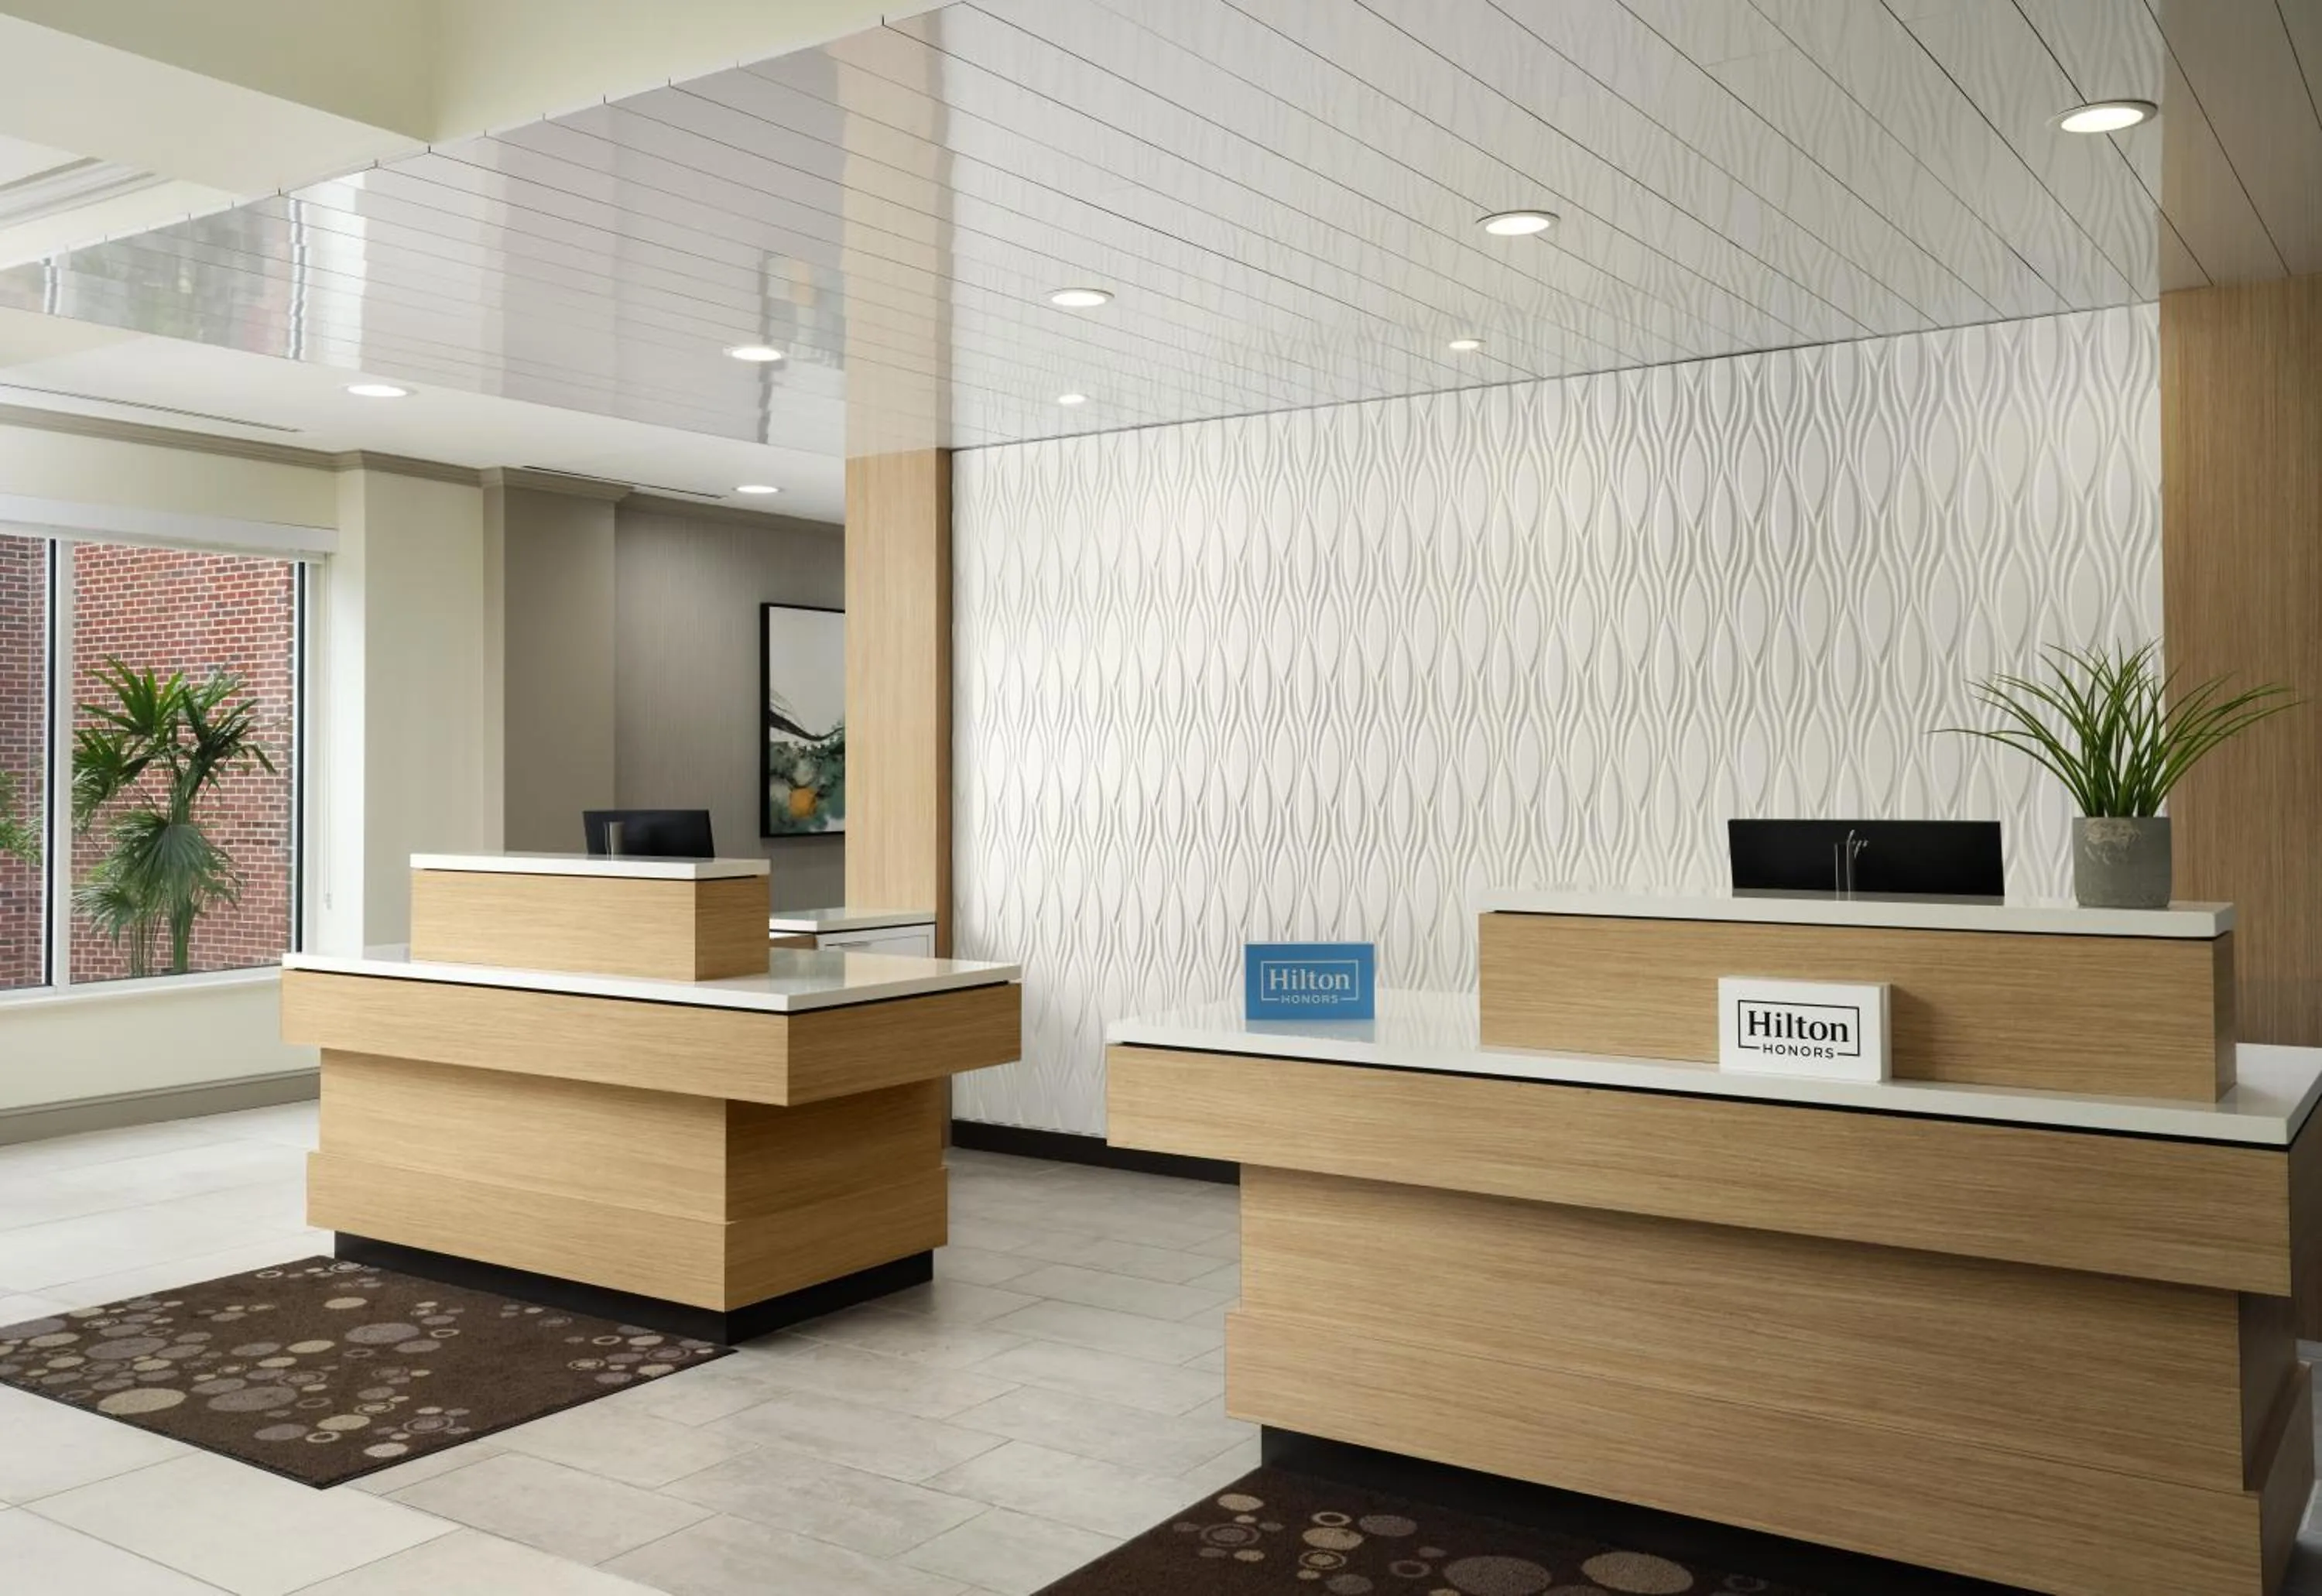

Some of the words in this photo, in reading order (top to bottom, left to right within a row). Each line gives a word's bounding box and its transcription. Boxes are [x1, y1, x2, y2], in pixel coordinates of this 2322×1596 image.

[1269, 968, 1351, 991] Hilton
[1281, 995, 1338, 1004] HONORS
[1748, 1010, 1849, 1043] Hilton
[1762, 1043, 1834, 1059] HONORS
